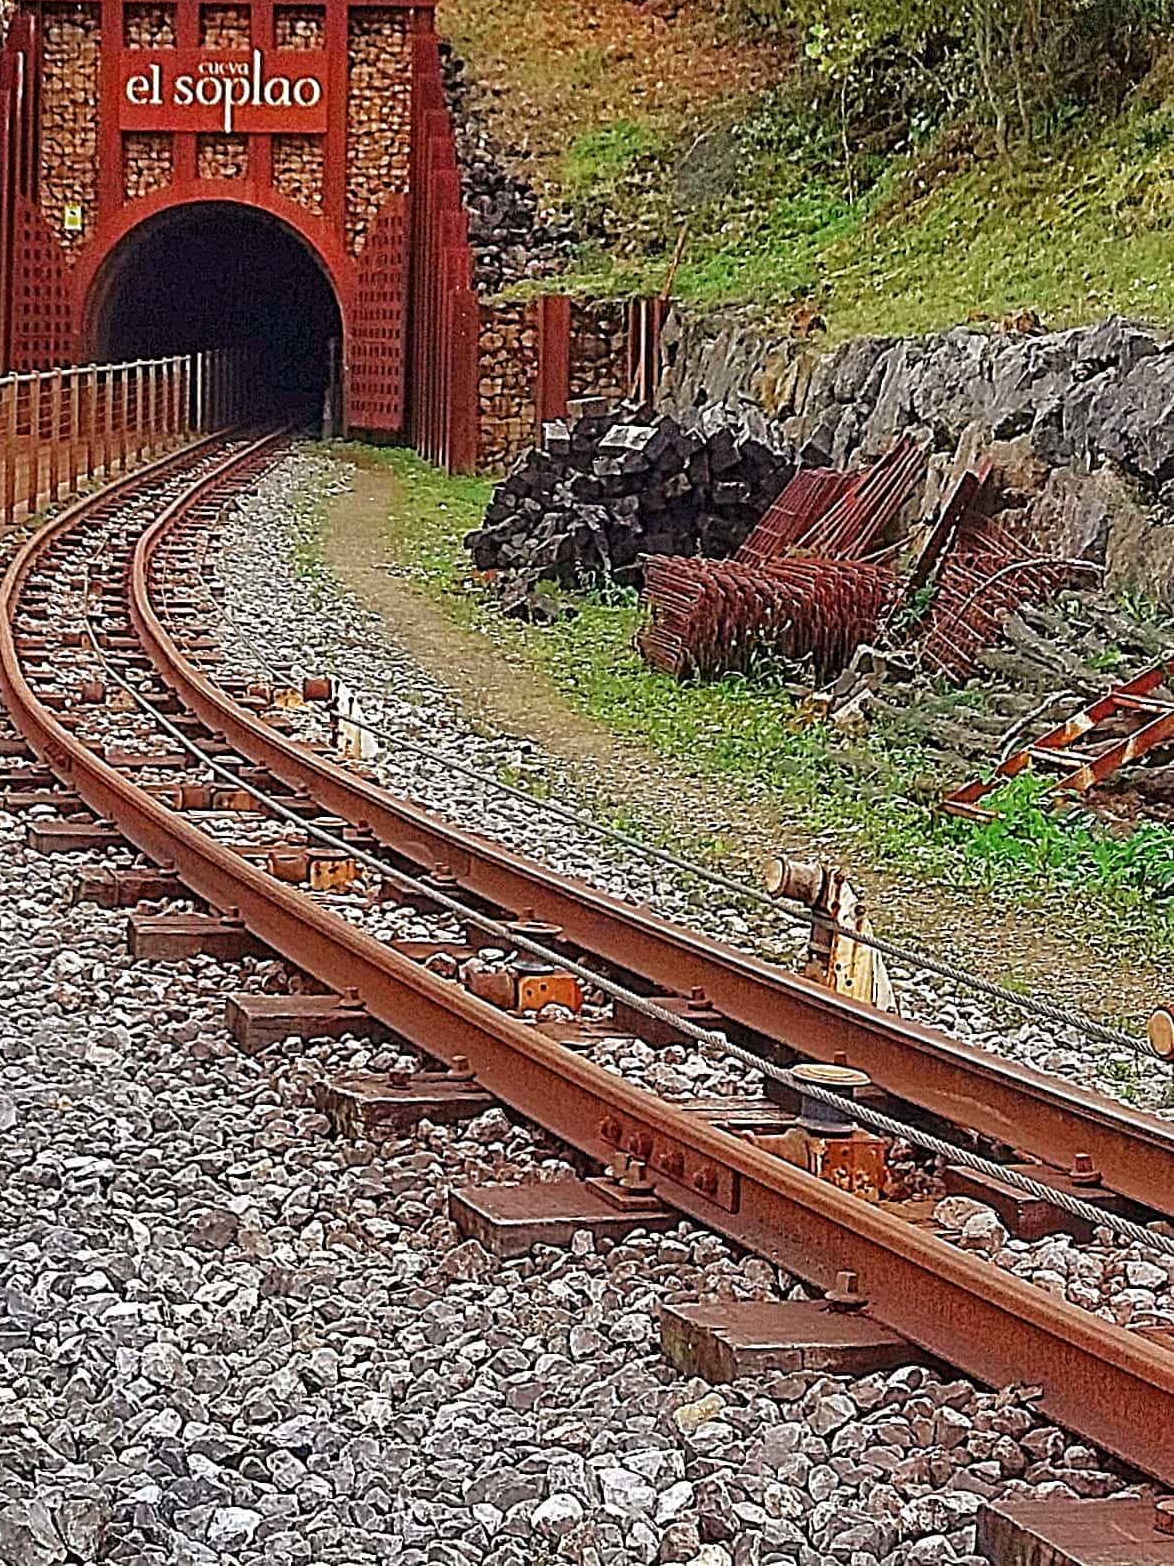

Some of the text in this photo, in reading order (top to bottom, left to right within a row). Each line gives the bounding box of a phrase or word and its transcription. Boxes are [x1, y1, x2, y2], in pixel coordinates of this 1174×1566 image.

[126, 49, 321, 133] el soplao
[198, 61, 250, 75] cueva
